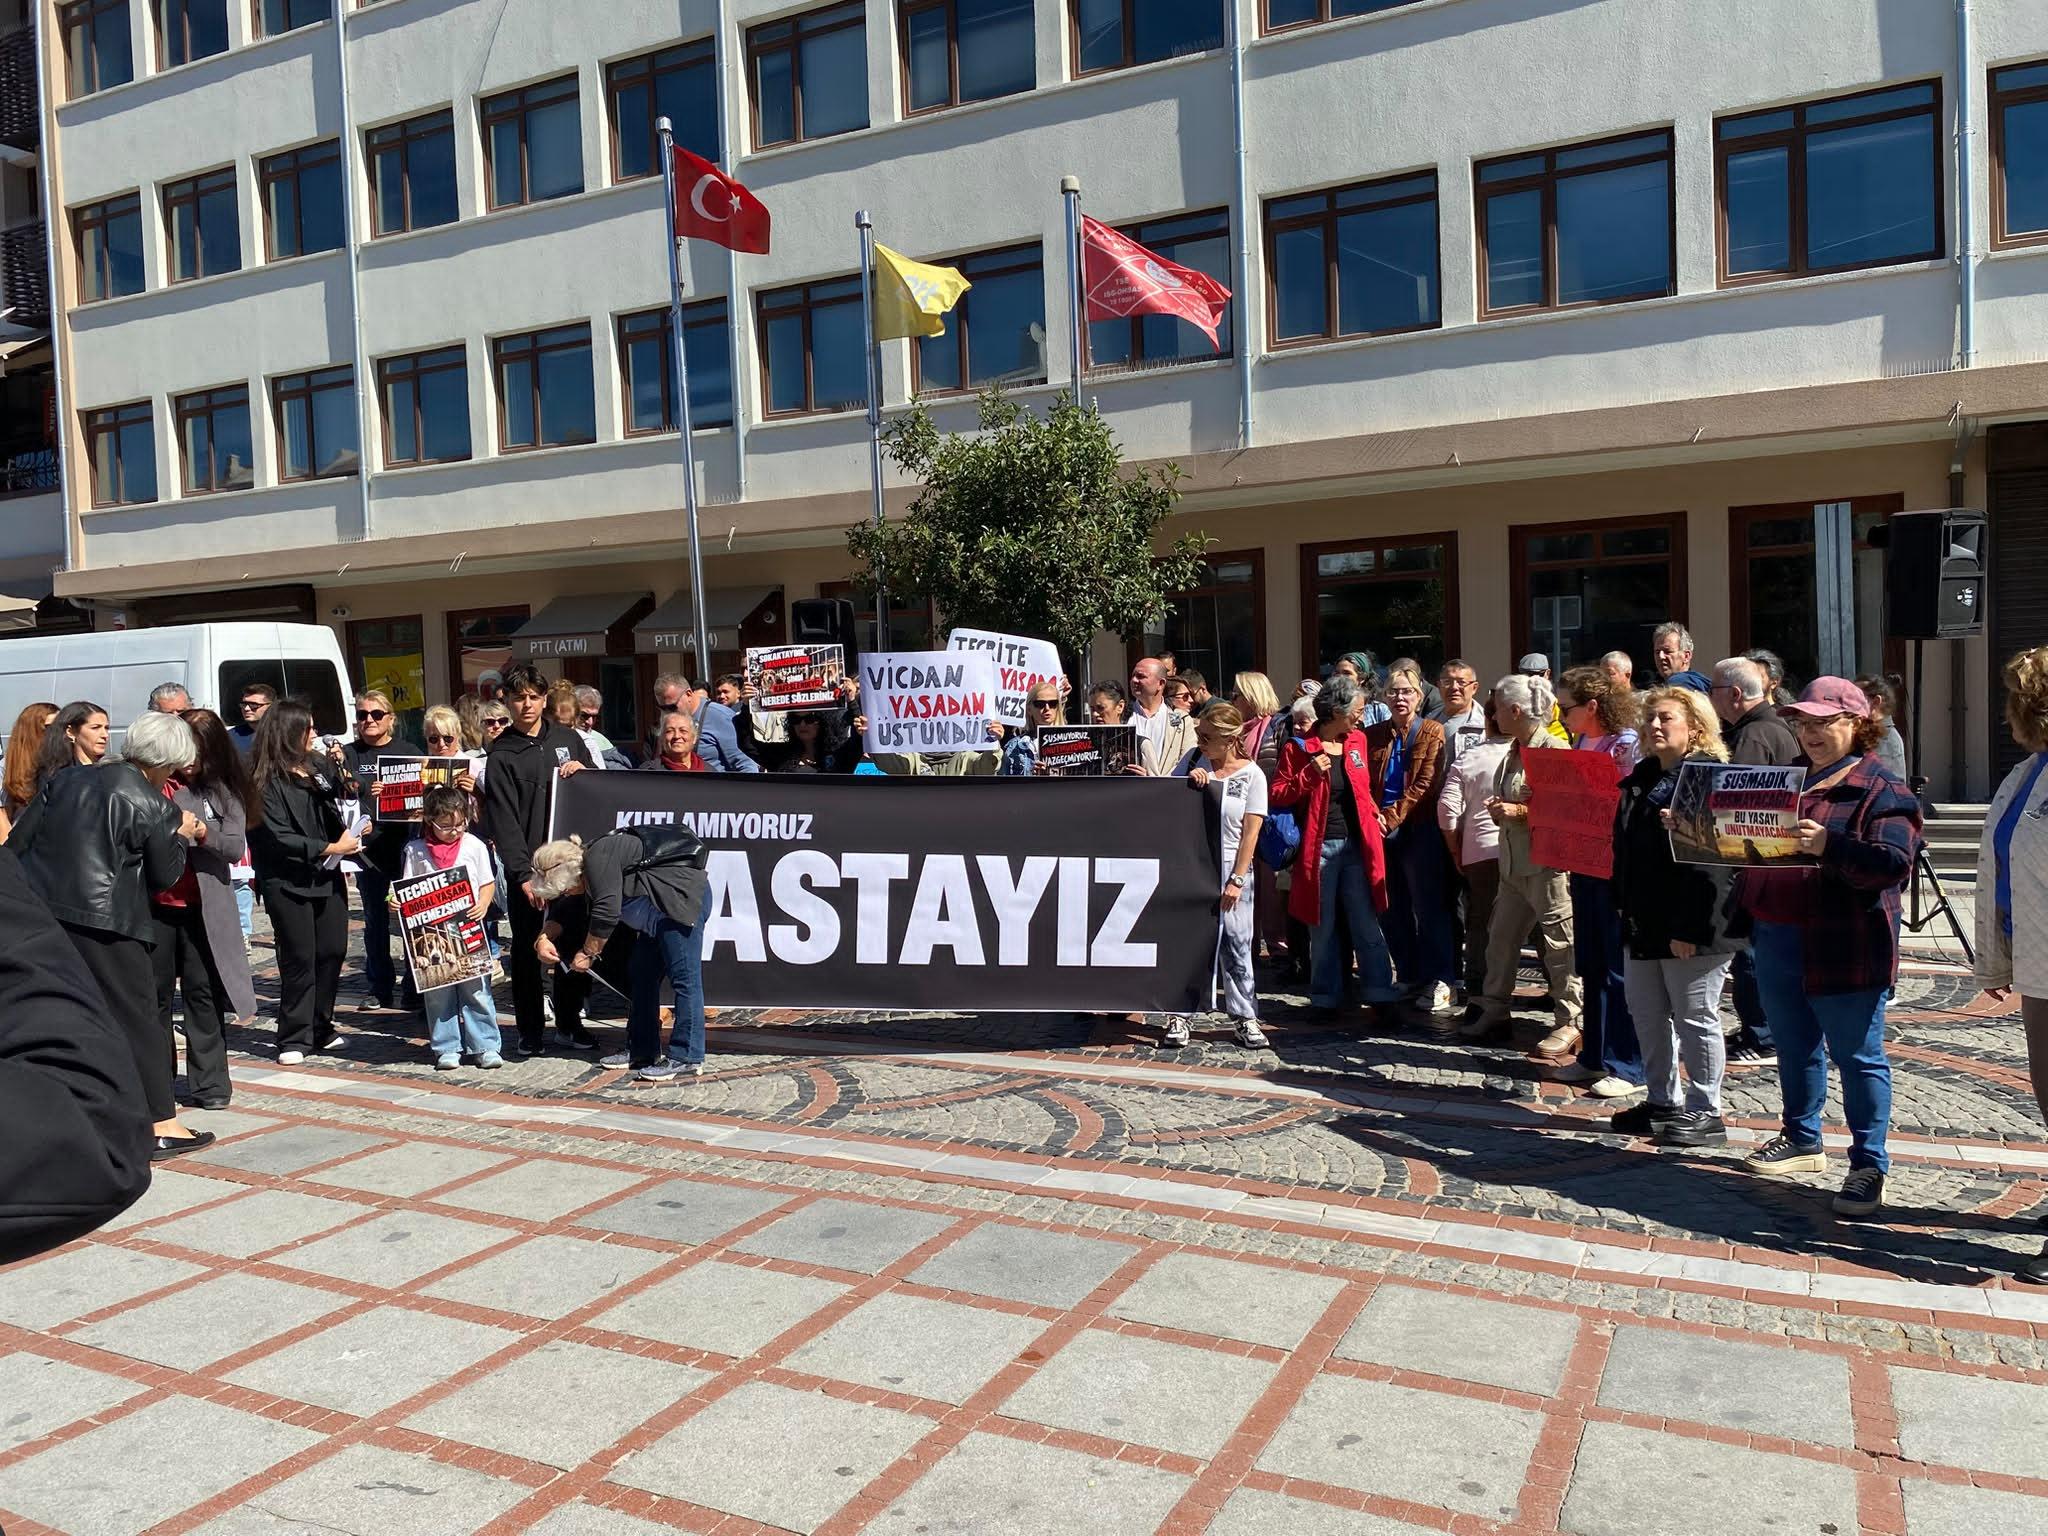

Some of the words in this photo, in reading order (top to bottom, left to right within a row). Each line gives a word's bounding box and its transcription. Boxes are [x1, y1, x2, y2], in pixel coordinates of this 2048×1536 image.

[530, 640, 552, 653] PTT
[554, 639, 588, 654] (ATM)
[655, 634, 679, 647] PTT
[867, 657, 964, 691] VİCDAN
[761, 694, 791, 707] NEREDE
[791, 687, 842, 704] SÖZLERİNİZ?
[381, 766, 390, 775] BU
[383, 771, 421, 785] ARKASINDA
[1722, 771, 1790, 790] SUSMADIK,
[1734, 811, 1745, 824] BU
[1748, 812, 1779, 826] YASAYI
[397, 872, 450, 903] TECRİTE
[408, 898, 435, 914] DOĞAL
[435, 883, 468, 904] YAŞAM
